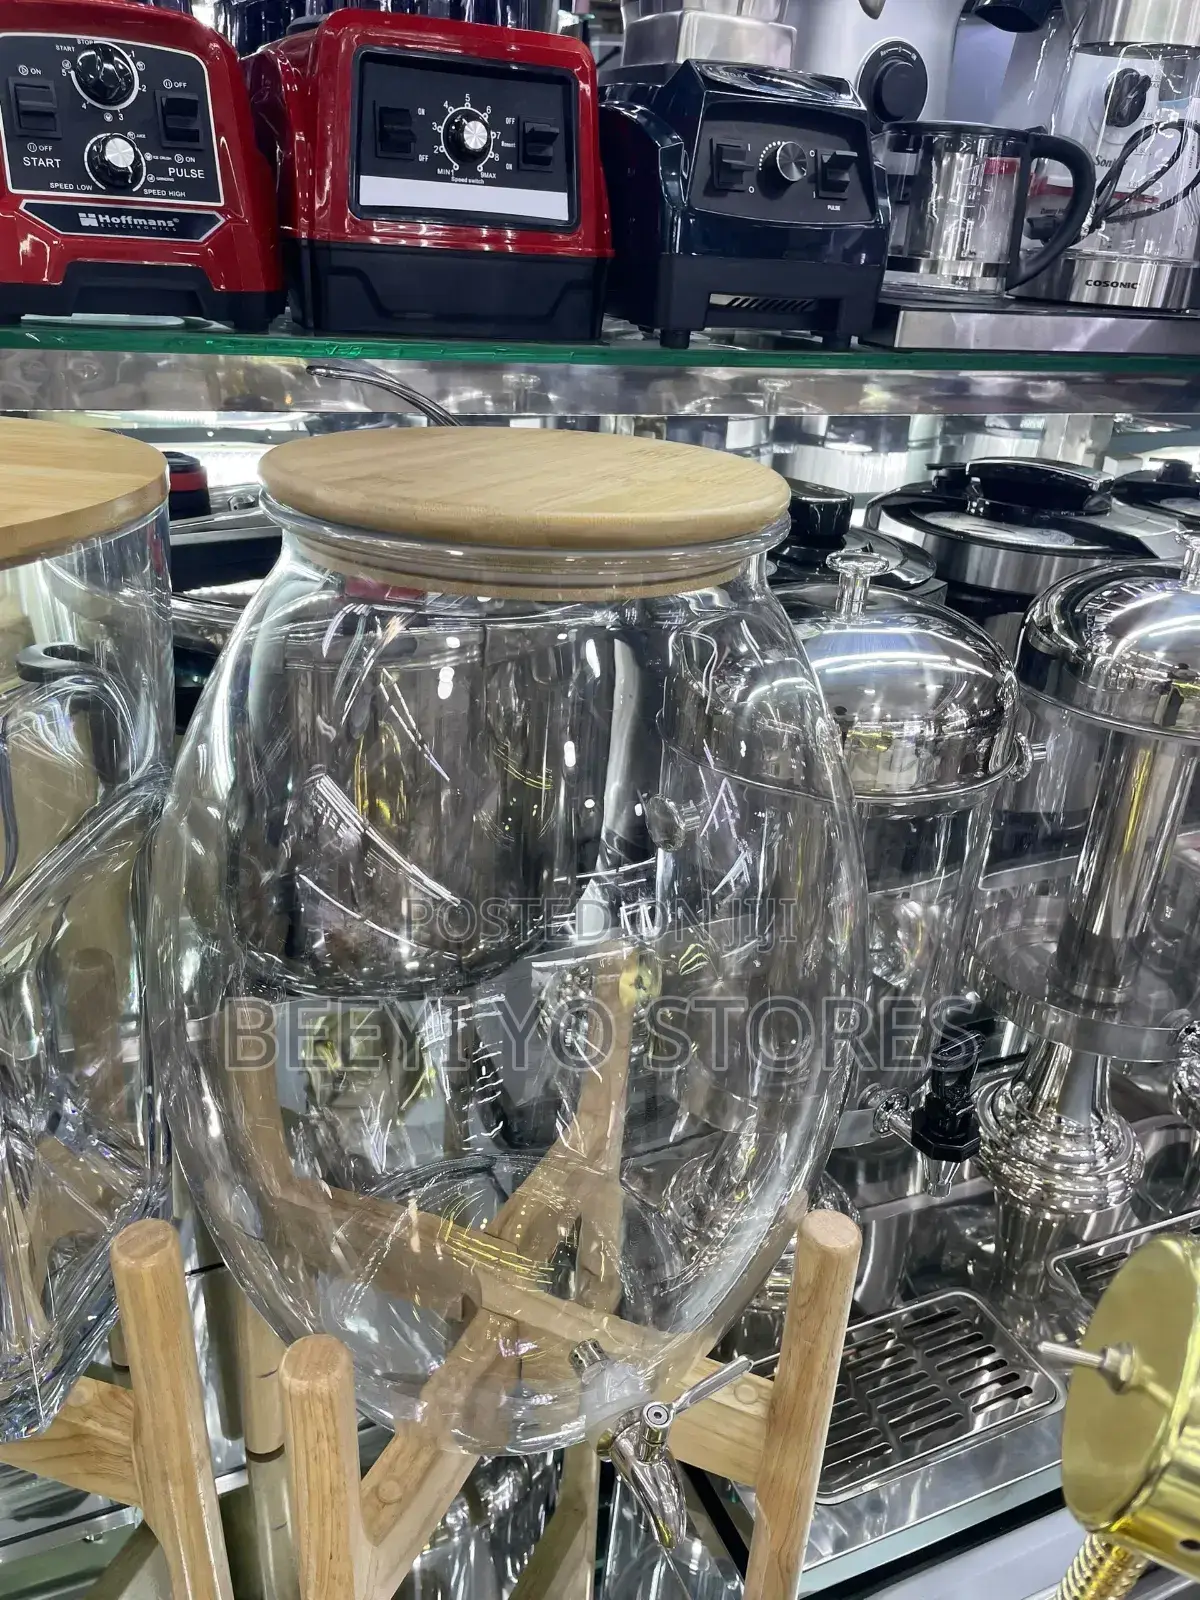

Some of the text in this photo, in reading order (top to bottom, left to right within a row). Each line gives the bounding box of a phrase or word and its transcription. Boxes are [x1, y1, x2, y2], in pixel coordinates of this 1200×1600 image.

[30, 67, 42, 75] ON
[465, 93, 471, 102] 5
[443, 100, 449, 109] 4
[418, 107, 426, 115] ON
[486, 105, 492, 114] 6
[119, 113, 124, 121] 3
[432, 122, 438, 131] 3
[496, 131, 501, 139] 7
[38, 144, 53, 152] OFF
[433, 145, 439, 154] 2
[418, 154, 429, 162] OFF
[494, 153, 500, 161] 8
[23, 156, 61, 168] START
[168, 167, 205, 179] PULSE
[49, 182, 74, 190] SPEED
[143, 188, 167, 196] SPEED
[1085, 279, 1138, 290] COSONIC
